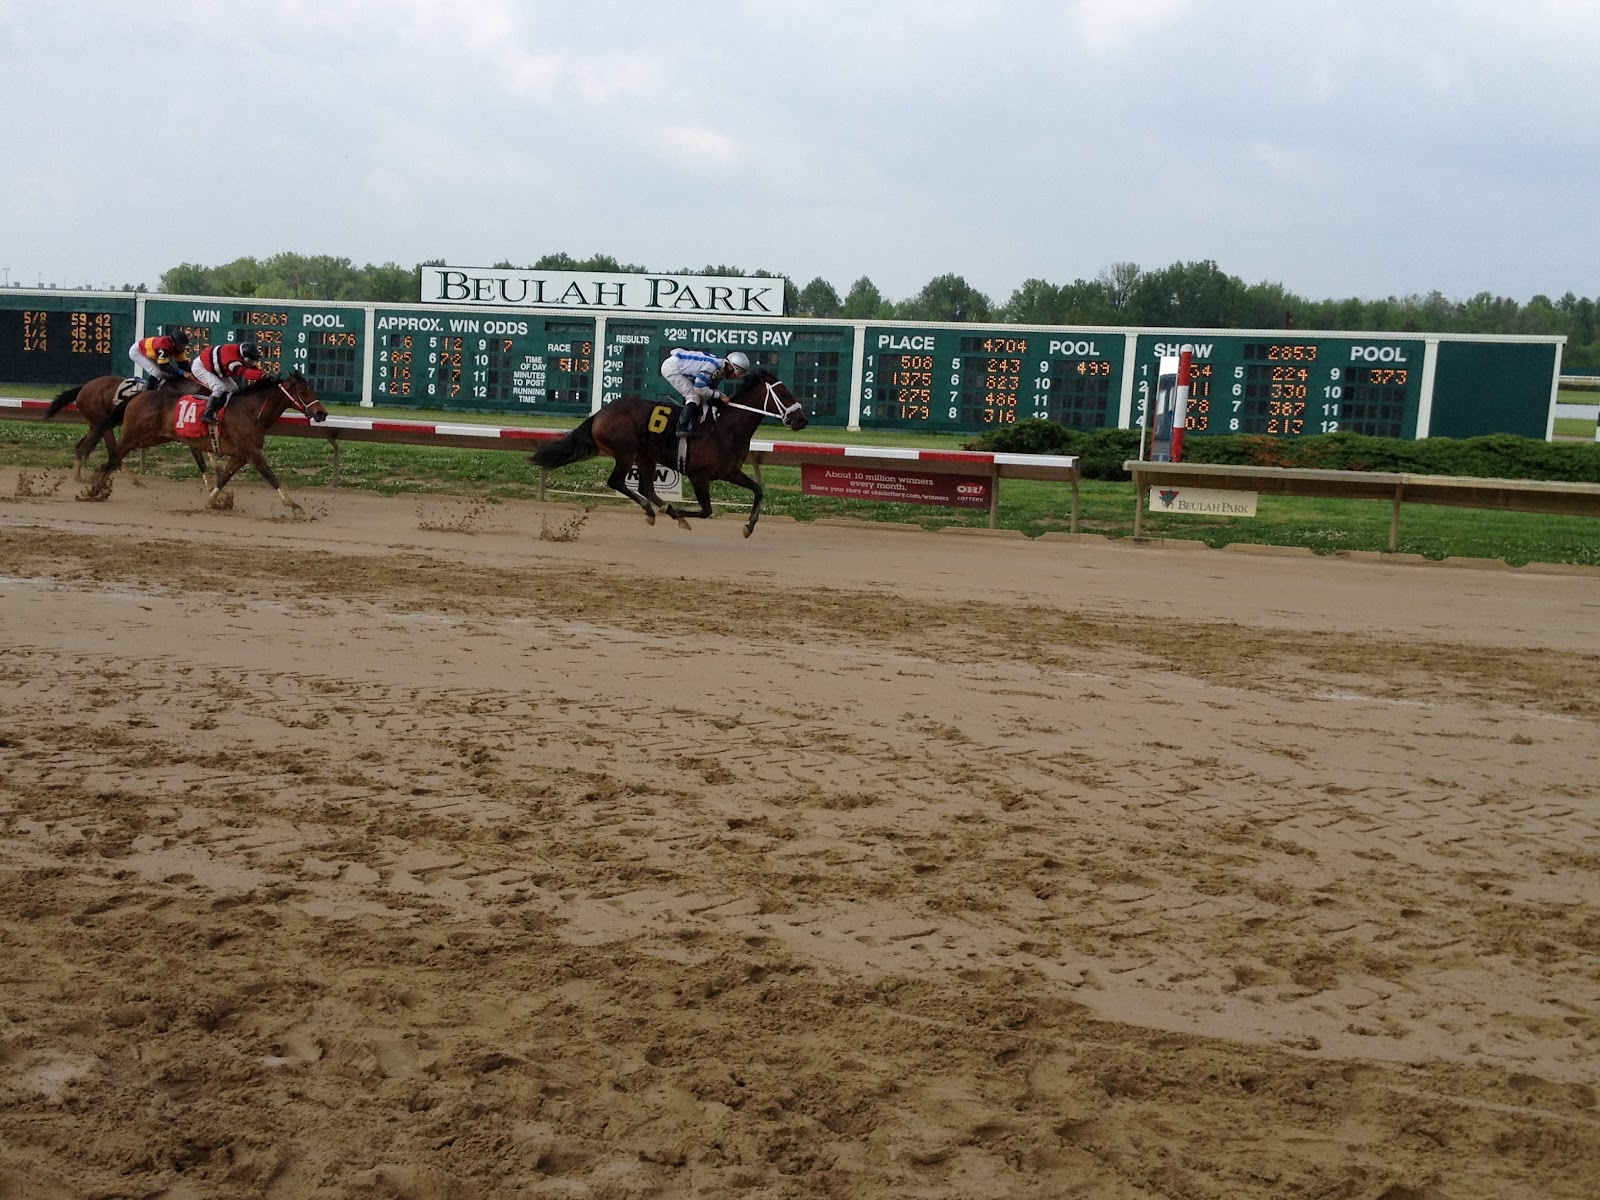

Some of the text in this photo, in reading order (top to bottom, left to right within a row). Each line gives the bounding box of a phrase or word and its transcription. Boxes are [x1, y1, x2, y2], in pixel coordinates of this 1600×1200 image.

[435, 270, 773, 312] BEULAH PARK
[24, 311, 47, 324] 5/8
[193, 309, 220, 323] WIN
[303, 314, 344, 328] POOL
[24, 325, 47, 338] 1/2
[157, 326, 162, 336] 1
[377, 317, 528, 335] APPROX. WIN ODDS
[227, 331, 234, 342] 5
[256, 330, 283, 344] 952
[298, 332, 306, 344] 9
[322, 333, 356, 346] 1476
[381, 335, 387, 346] 1
[404, 336, 412, 348] 6
[429, 337, 437, 348] 5
[616, 335, 650, 344] RESULTS
[691, 328, 758, 344] TICKETS
[762, 331, 793, 346] PAY
[878, 334, 935, 350] PLACE
[24, 338, 111, 354] 1/4 22.42
[478, 340, 486, 350] 9
[504, 340, 512, 352] 7
[547, 344, 571, 352] RACE
[582, 342, 592, 355] 8
[606, 344, 624, 356] 1ST
[984, 338, 1026, 354] 4704
[1048, 340, 1100, 356] POOL
[1154, 343, 1213, 358] SHW
[158, 350, 164, 360] 2
[294, 348, 308, 358] 10
[380, 351, 388, 362] 2
[428, 353, 436, 364] 6
[1350, 346, 1407, 362] POOL
[474, 355, 488, 366] 10
[524, 356, 542, 364] TIME
[604, 360, 624, 372] 2ND
[868, 355, 873, 366] 1
[952, 358, 960, 370] 5
[988, 358, 1020, 373] 243
[293, 362, 306, 374] 11
[380, 366, 388, 377] 3
[1040, 360, 1049, 373] 9
[1077, 362, 1110, 376] 499
[1141, 364, 1148, 376] 1
[1188, 364, 1212, 378] 34
[1234, 366, 1244, 378] 5
[428, 368, 436, 378] 7
[452, 369, 461, 381] 7
[474, 371, 486, 382] 11
[513, 370, 546, 380] MINUTES
[865, 372, 874, 382] 2
[893, 372, 932, 386] 1375
[1272, 366, 1308, 382] 224
[1330, 368, 1340, 380] 9
[1370, 369, 1408, 384] 373
[513, 378, 523, 386] TO
[604, 376, 623, 388] 3RD
[950, 374, 960, 386] 6
[986, 376, 1019, 390] 823
[1034, 378, 1051, 390] 10
[1138, 380, 1148, 392] 2
[378, 382, 386, 392] 4
[390, 382, 411, 395] 25
[428, 384, 436, 394] 8
[451, 384, 460, 398] 7
[473, 386, 486, 397] 12
[512, 387, 546, 396] RUNNING
[1232, 384, 1242, 396] 6
[1271, 384, 1307, 398] 330
[1324, 386, 1342, 398] 10
[864, 388, 872, 400] 3
[898, 388, 930, 402] 275
[950, 391, 958, 402] 7
[1033, 394, 1048, 406] 11
[862, 405, 872, 416] 4
[1137, 399, 1146, 410] 3
[1232, 400, 1242, 412] 7
[1270, 402, 1306, 416] 387
[1322, 404, 1338, 416] 11
[176, 400, 197, 428] 1A
[902, 406, 930, 420] 179
[948, 407, 958, 418] 8
[984, 409, 1016, 424] 316
[648, 405, 672, 434] 6
[1230, 418, 1239, 430] 8
[1268, 418, 1304, 434] 213
[1320, 421, 1339, 433] 12
[825, 470, 934, 486] About 10 million winners
[850, 480, 908, 491] every month.
[1178, 500, 1248, 514] BEULAH PARK
